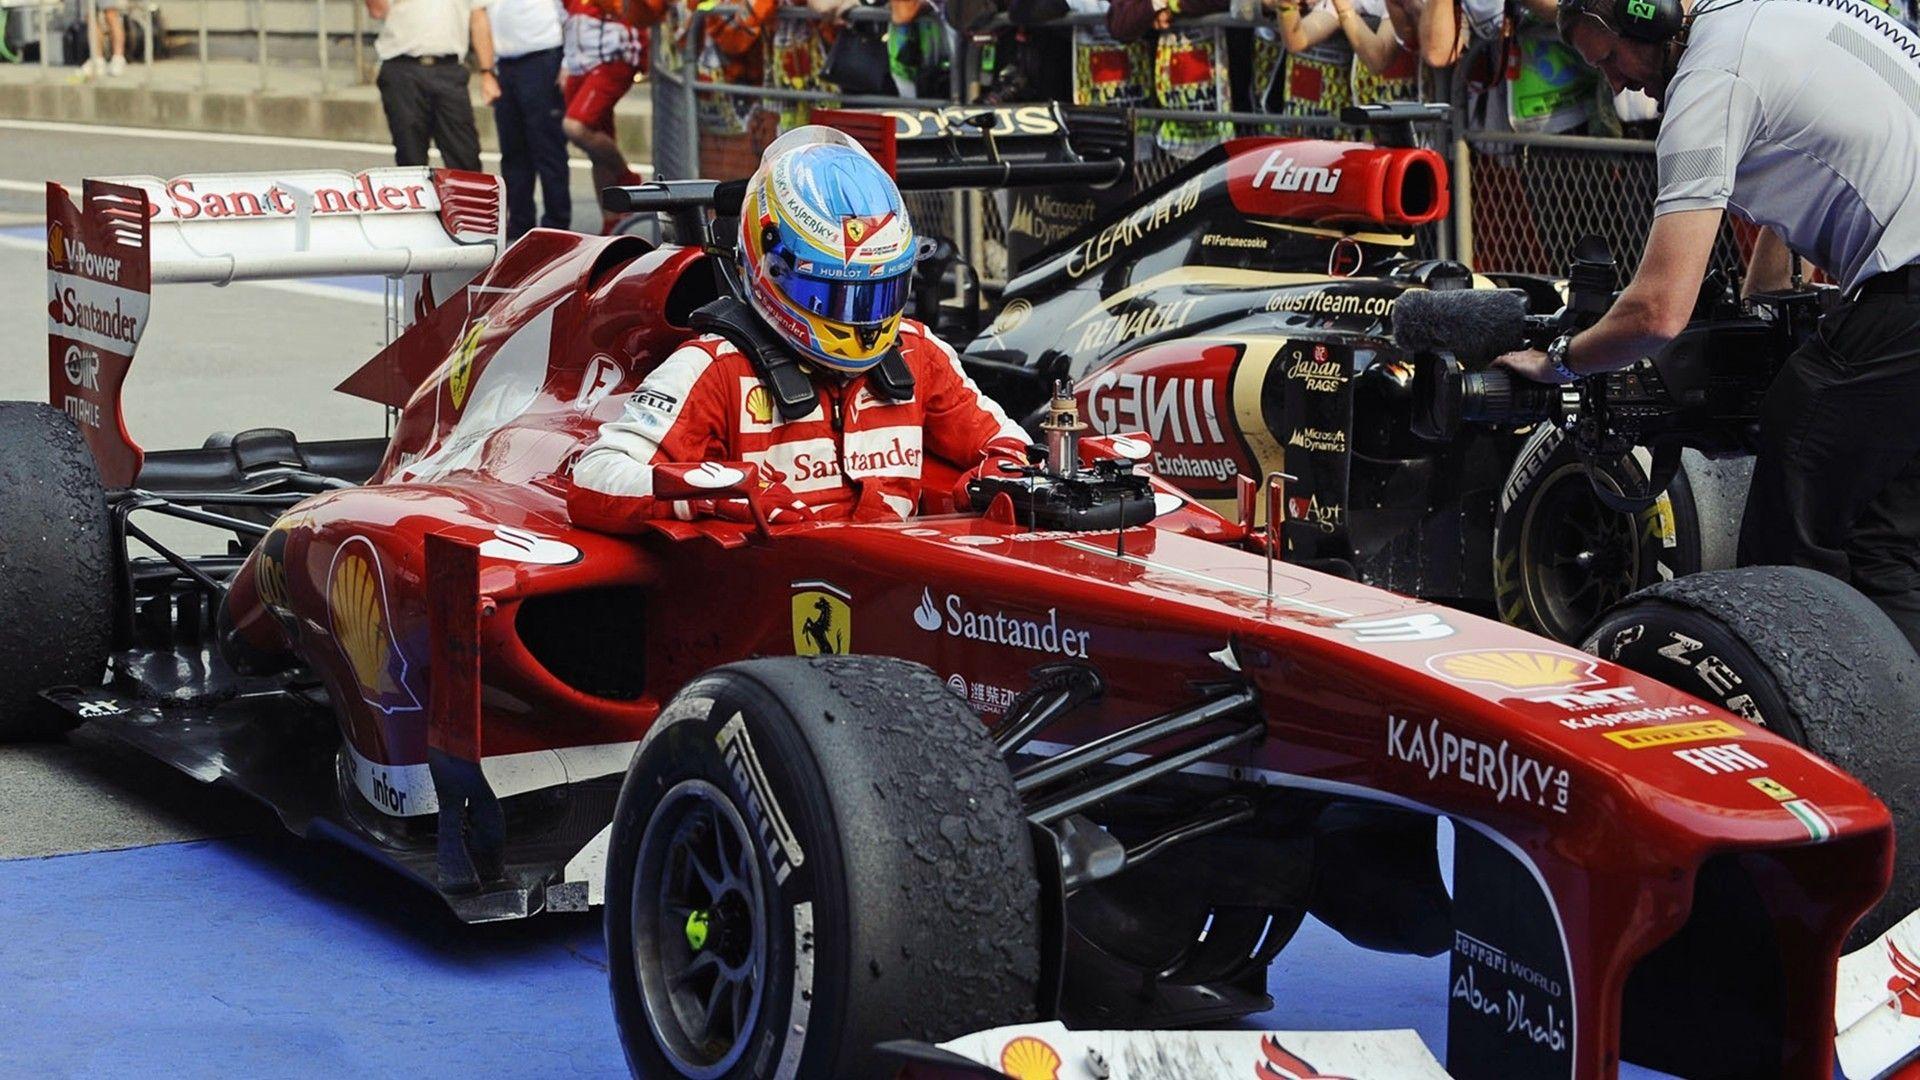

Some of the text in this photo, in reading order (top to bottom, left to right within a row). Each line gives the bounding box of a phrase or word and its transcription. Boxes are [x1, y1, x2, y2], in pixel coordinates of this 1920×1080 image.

[896, 105, 1059, 138] OTUS
[166, 173, 426, 219] Santnder
[787, 198, 834, 237] KASPERSKY
[819, 267, 862, 279] HUBLOT
[62, 287, 137, 344] Santander
[1076, 297, 1206, 352] RENAULT
[1288, 350, 1342, 381] Japan
[1306, 378, 1340, 393] RAGS
[65, 395, 100, 428] MAHLE
[1305, 428, 1345, 443] Microsoft
[1305, 439, 1345, 452] Dynamics
[794, 438, 921, 482] Santander
[946, 594, 1091, 658] Santander
[970, 682, 1021, 707] 潍柴动
[1559, 705, 1690, 730] KASPERSKY
[1387, 715, 1570, 814] KASPERSKY lab
[1672, 744, 1769, 775] FIAT
[372, 767, 407, 814] infor
[1456, 930, 1561, 997] Ferrari WORLD
[1453, 965, 1565, 1051] Abu Dhabi
